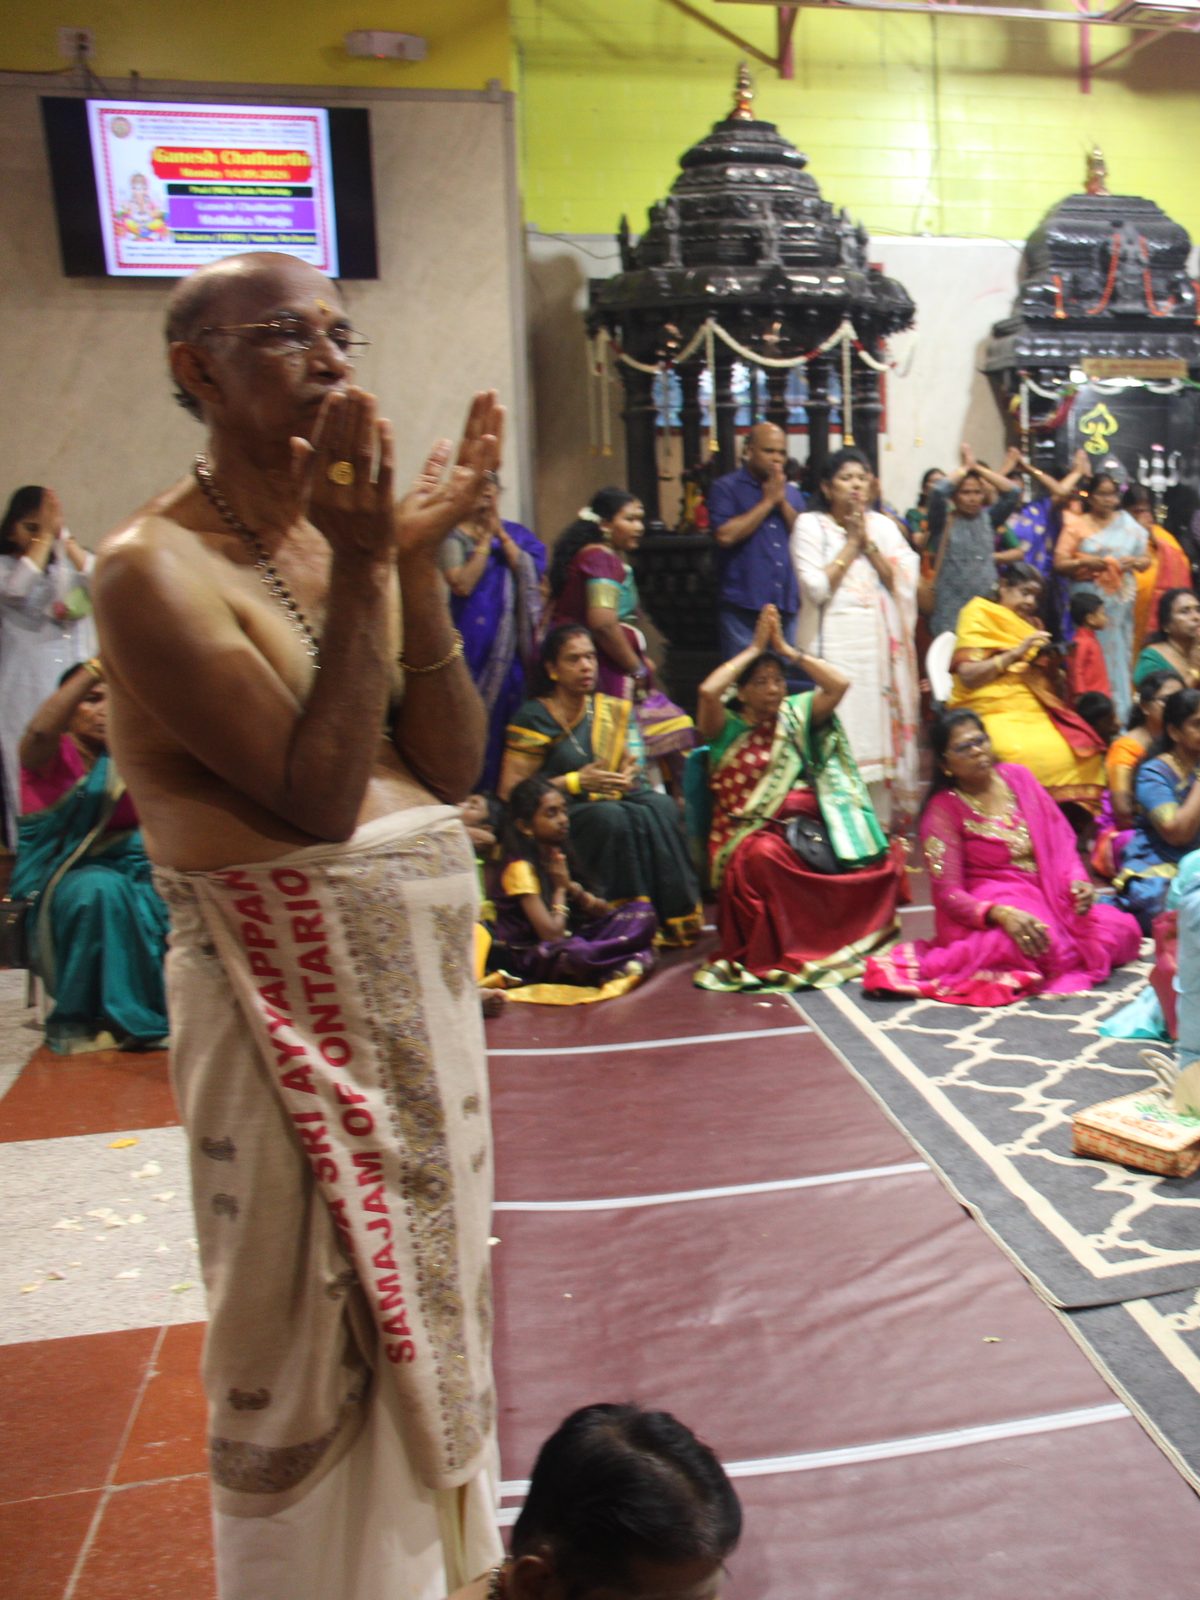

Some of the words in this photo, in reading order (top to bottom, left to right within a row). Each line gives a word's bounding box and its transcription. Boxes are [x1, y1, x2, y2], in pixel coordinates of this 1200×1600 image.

[154, 149, 219, 164] Ganesh
[213, 870, 318, 1094] AYYAPPAN
[271, 868, 352, 1067] ONTARIO
[333, 1082, 376, 1137] OF
[352, 1152, 416, 1364] SAMAJAM
